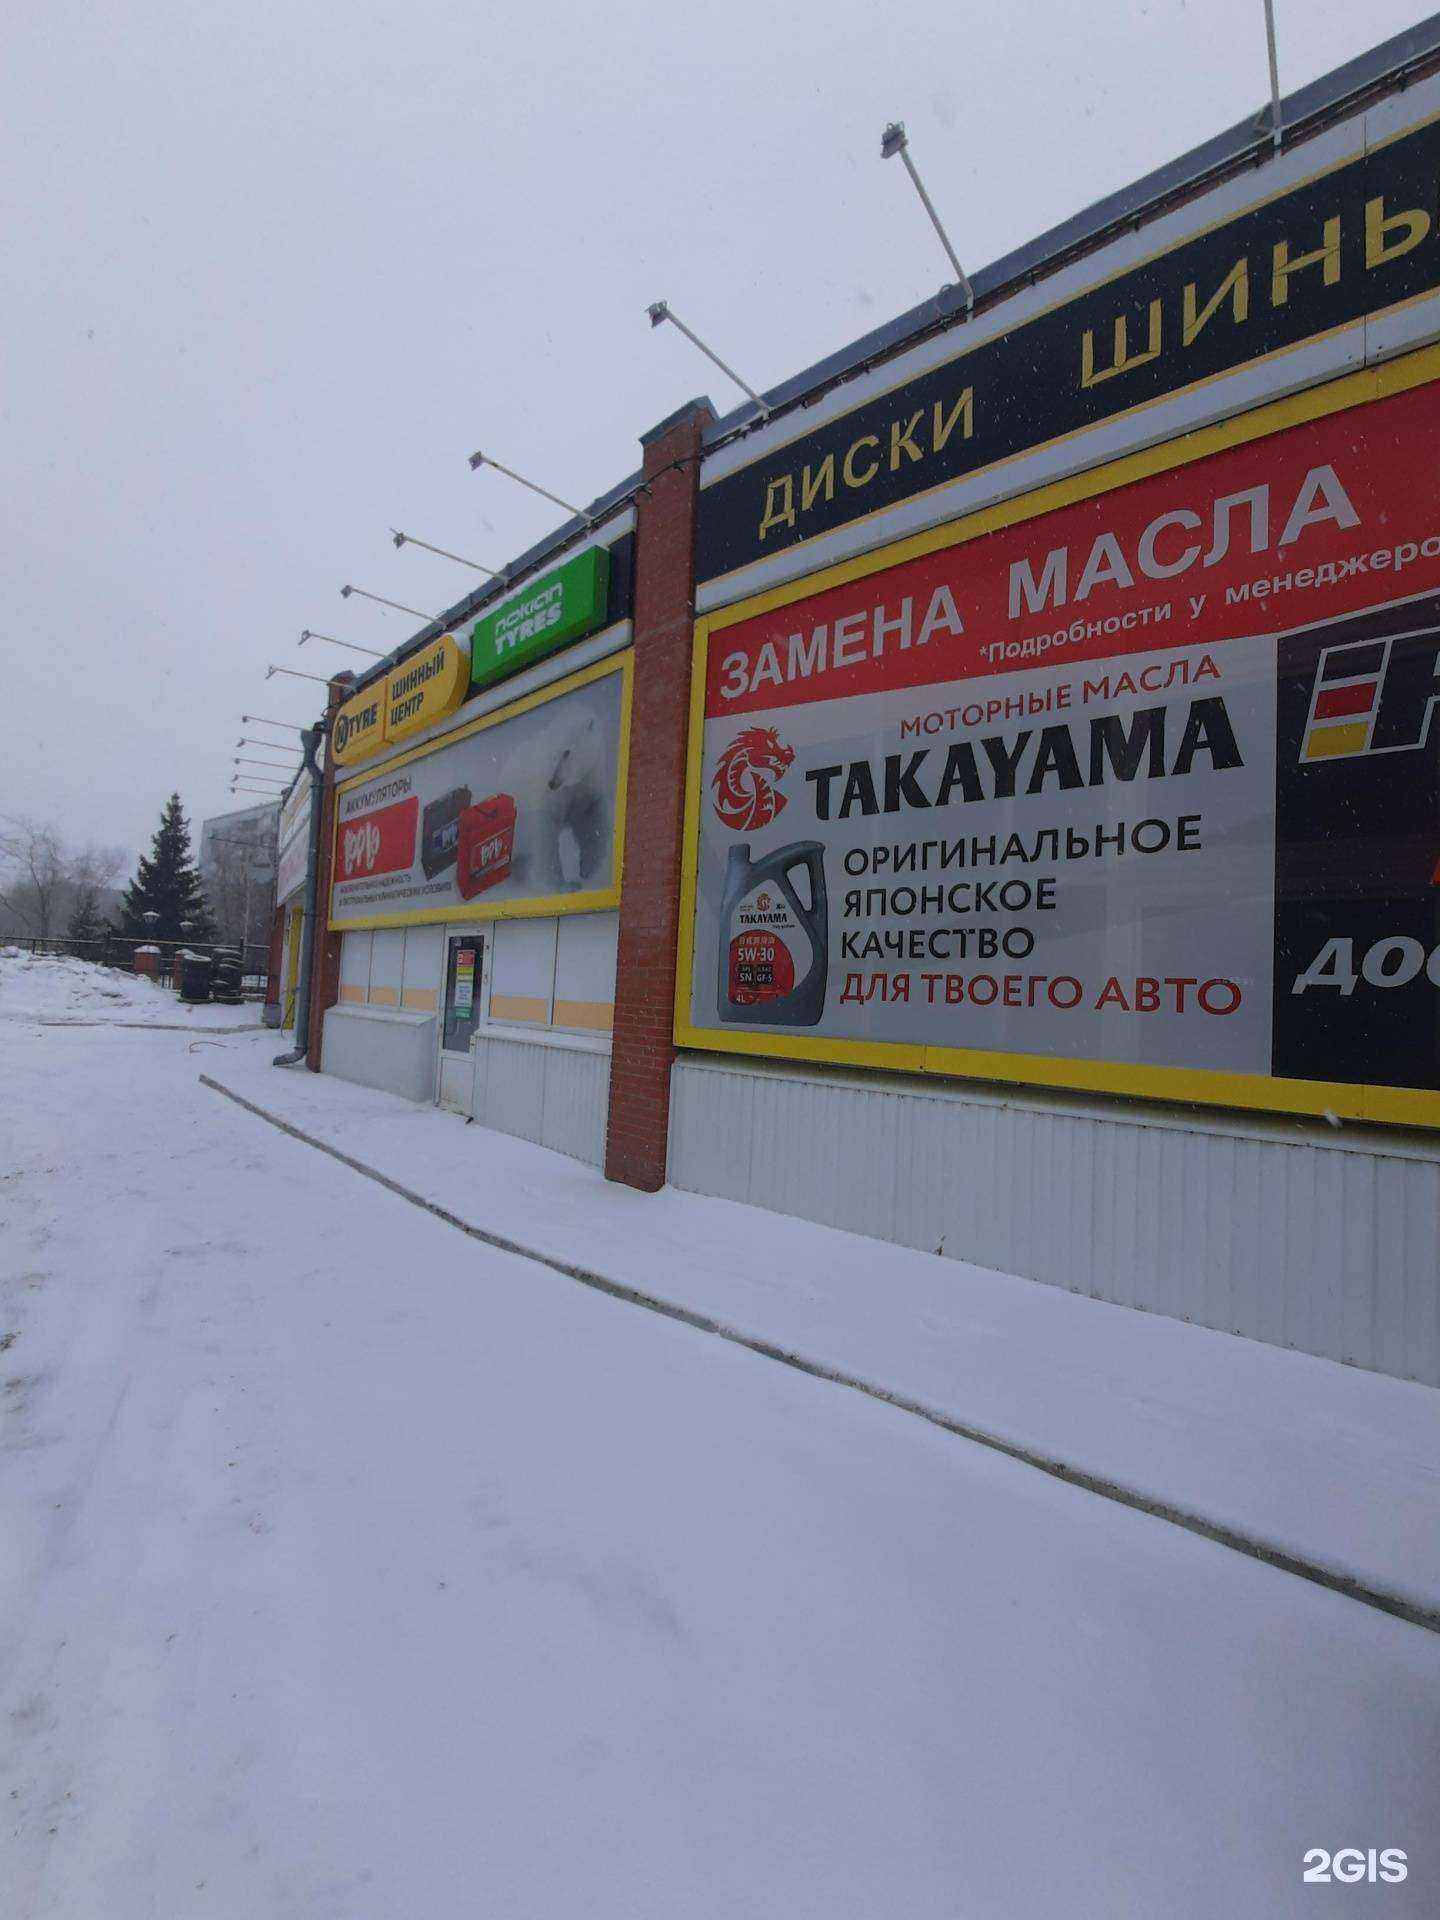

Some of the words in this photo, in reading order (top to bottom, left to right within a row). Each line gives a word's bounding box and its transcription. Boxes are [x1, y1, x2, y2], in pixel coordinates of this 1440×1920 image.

[758, 386, 975, 541] ДИСКИ
[719, 584, 965, 701] ЗАМЕНА
[1007, 464, 1361, 620] МАСЛА
[1189, 597, 1207, 619] у
[392, 646, 445, 701] ШИННЫЙ
[391, 691, 424, 727] ЦЕНТР
[899, 684, 1073, 741] МОТОРНЫЕ
[1082, 654, 1222, 705] МАСЛА
[805, 696, 1245, 822] TAKAYAMA
[843, 814, 1203, 877] ОРИГИНАЛЬНОЕ
[740, 913, 787, 924] TAKAYAMA
[843, 878, 1057, 919] ЯПОНСКОЕ
[738, 947, 775, 962] 5W-30
[841, 927, 1036, 960] КАЧЕСТВО
[839, 972, 920, 1006] ДЛЯ
[921, 973, 1084, 1011] ТВОЕГО
[1095, 976, 1243, 1016] АВТО
